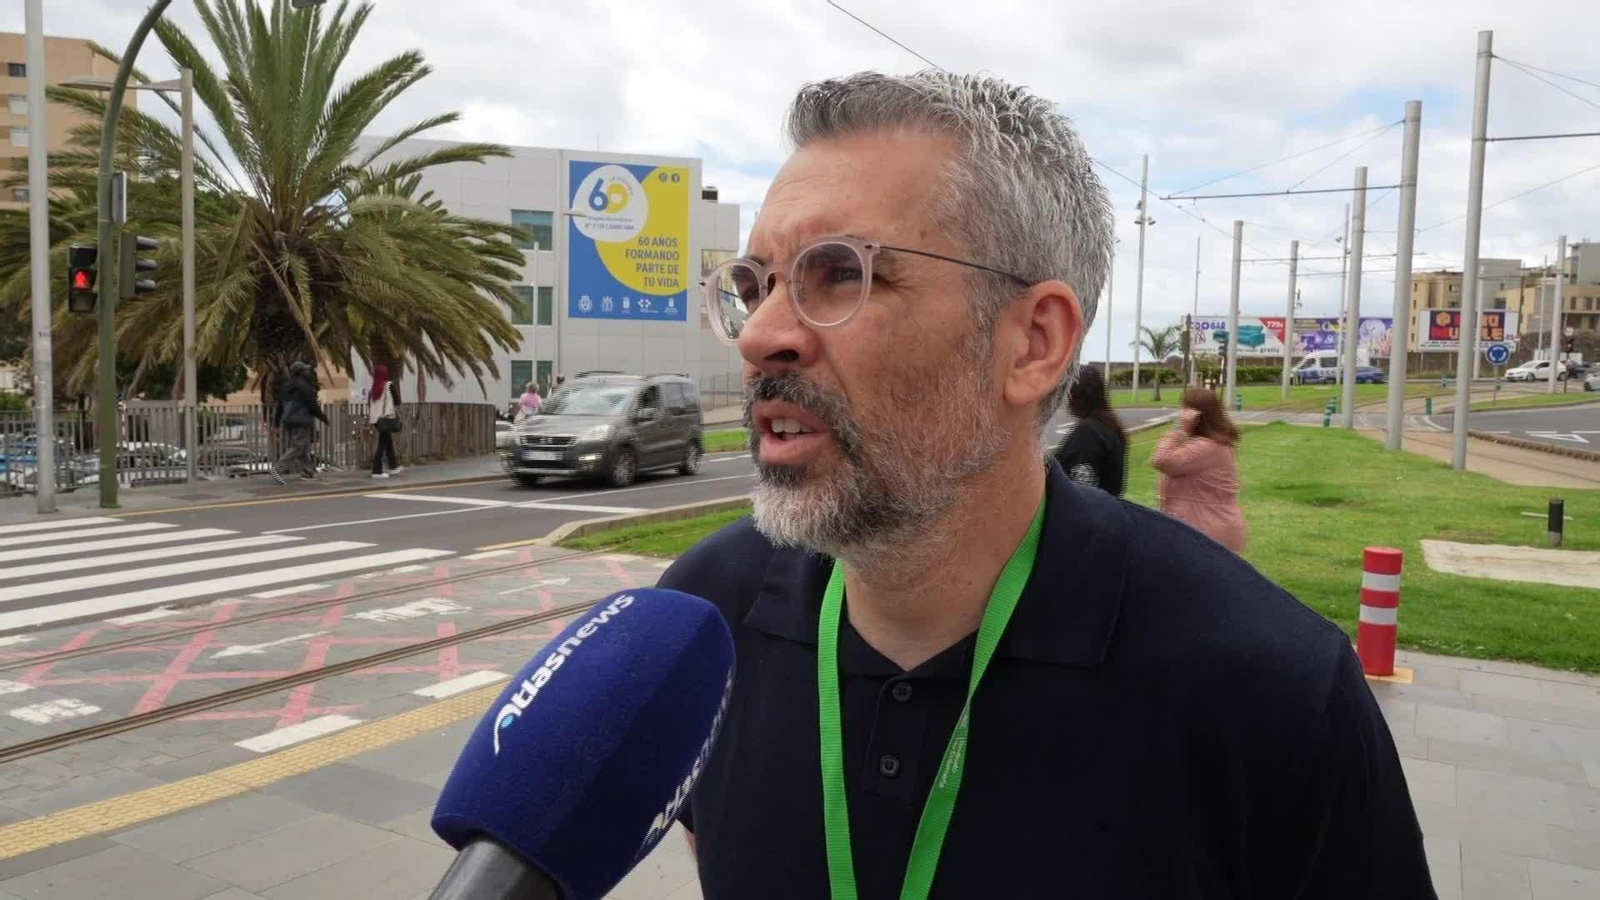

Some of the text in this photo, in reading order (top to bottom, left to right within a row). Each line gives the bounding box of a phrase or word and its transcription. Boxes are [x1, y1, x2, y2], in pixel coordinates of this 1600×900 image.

[638, 234, 678, 248] 60 AÑOS
[625, 248, 680, 261] FORMANDO
[636, 262, 680, 275] PARTE DE
[643, 276, 680, 288] TU VIDA
